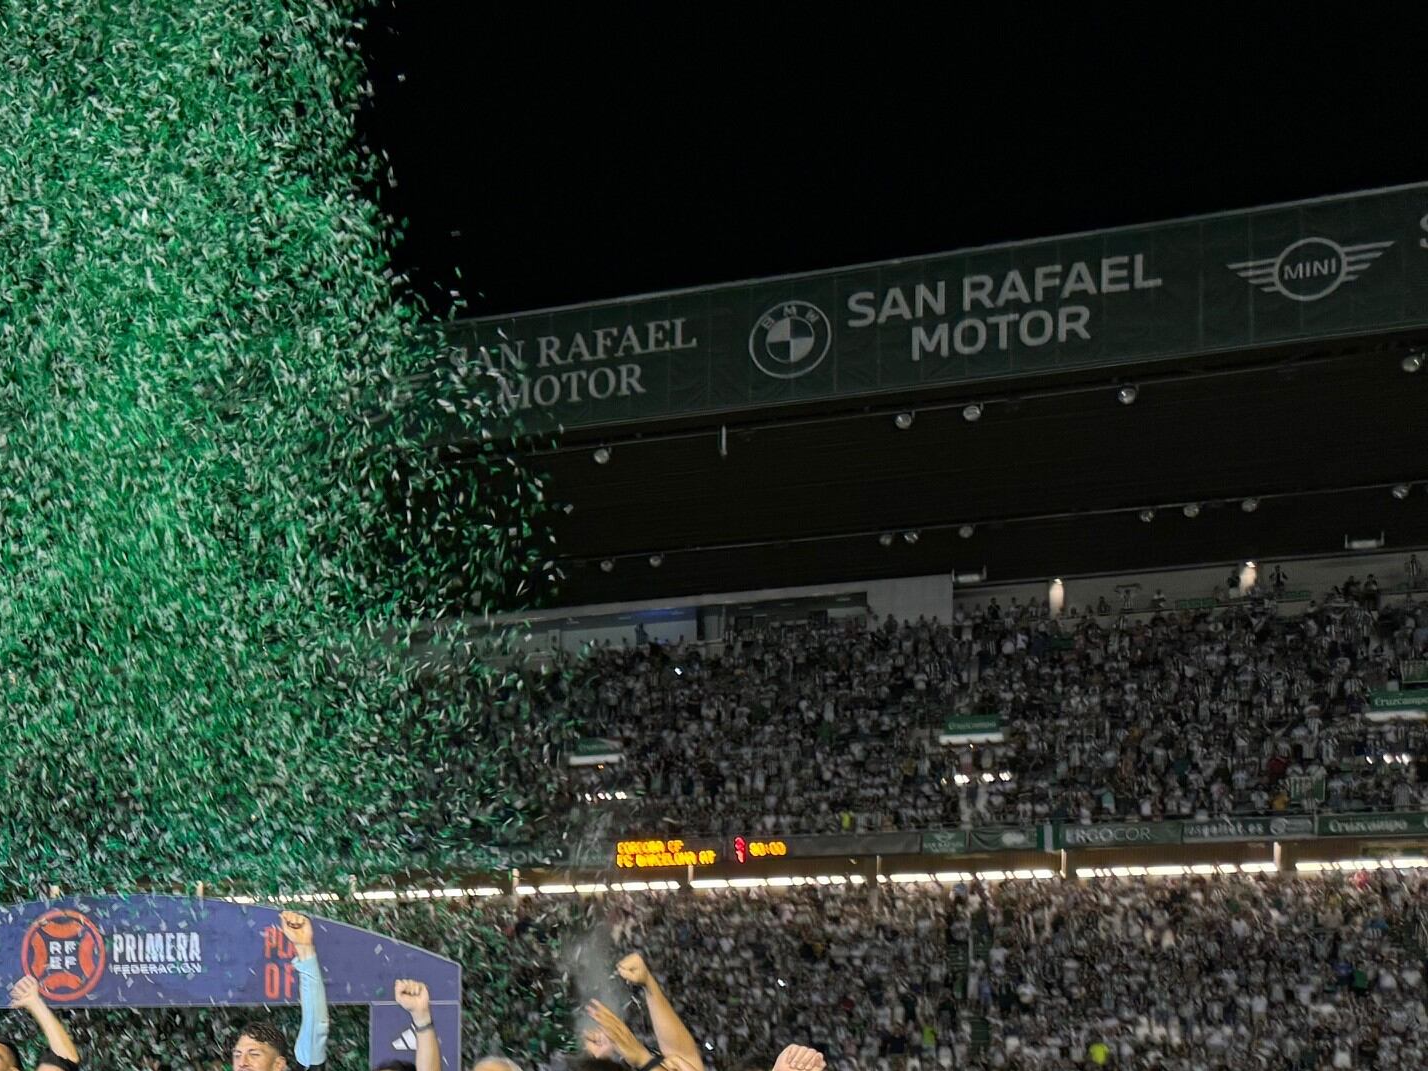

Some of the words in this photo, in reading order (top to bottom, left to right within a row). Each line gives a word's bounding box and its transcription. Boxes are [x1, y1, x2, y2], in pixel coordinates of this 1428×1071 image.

[1283, 256, 1337, 280] MINI
[847, 280, 946, 328] SAN
[962, 252, 1164, 313] RAFAEL
[759, 304, 821, 330] BMW
[911, 304, 1091, 361] MOTOR
[537, 317, 698, 369] RAFAEL
[497, 362, 647, 411] MOTOR
[1064, 827, 1152, 844] ERGOCOR
[112, 931, 202, 963] PRIMERA
[264, 962, 294, 1000] OF
